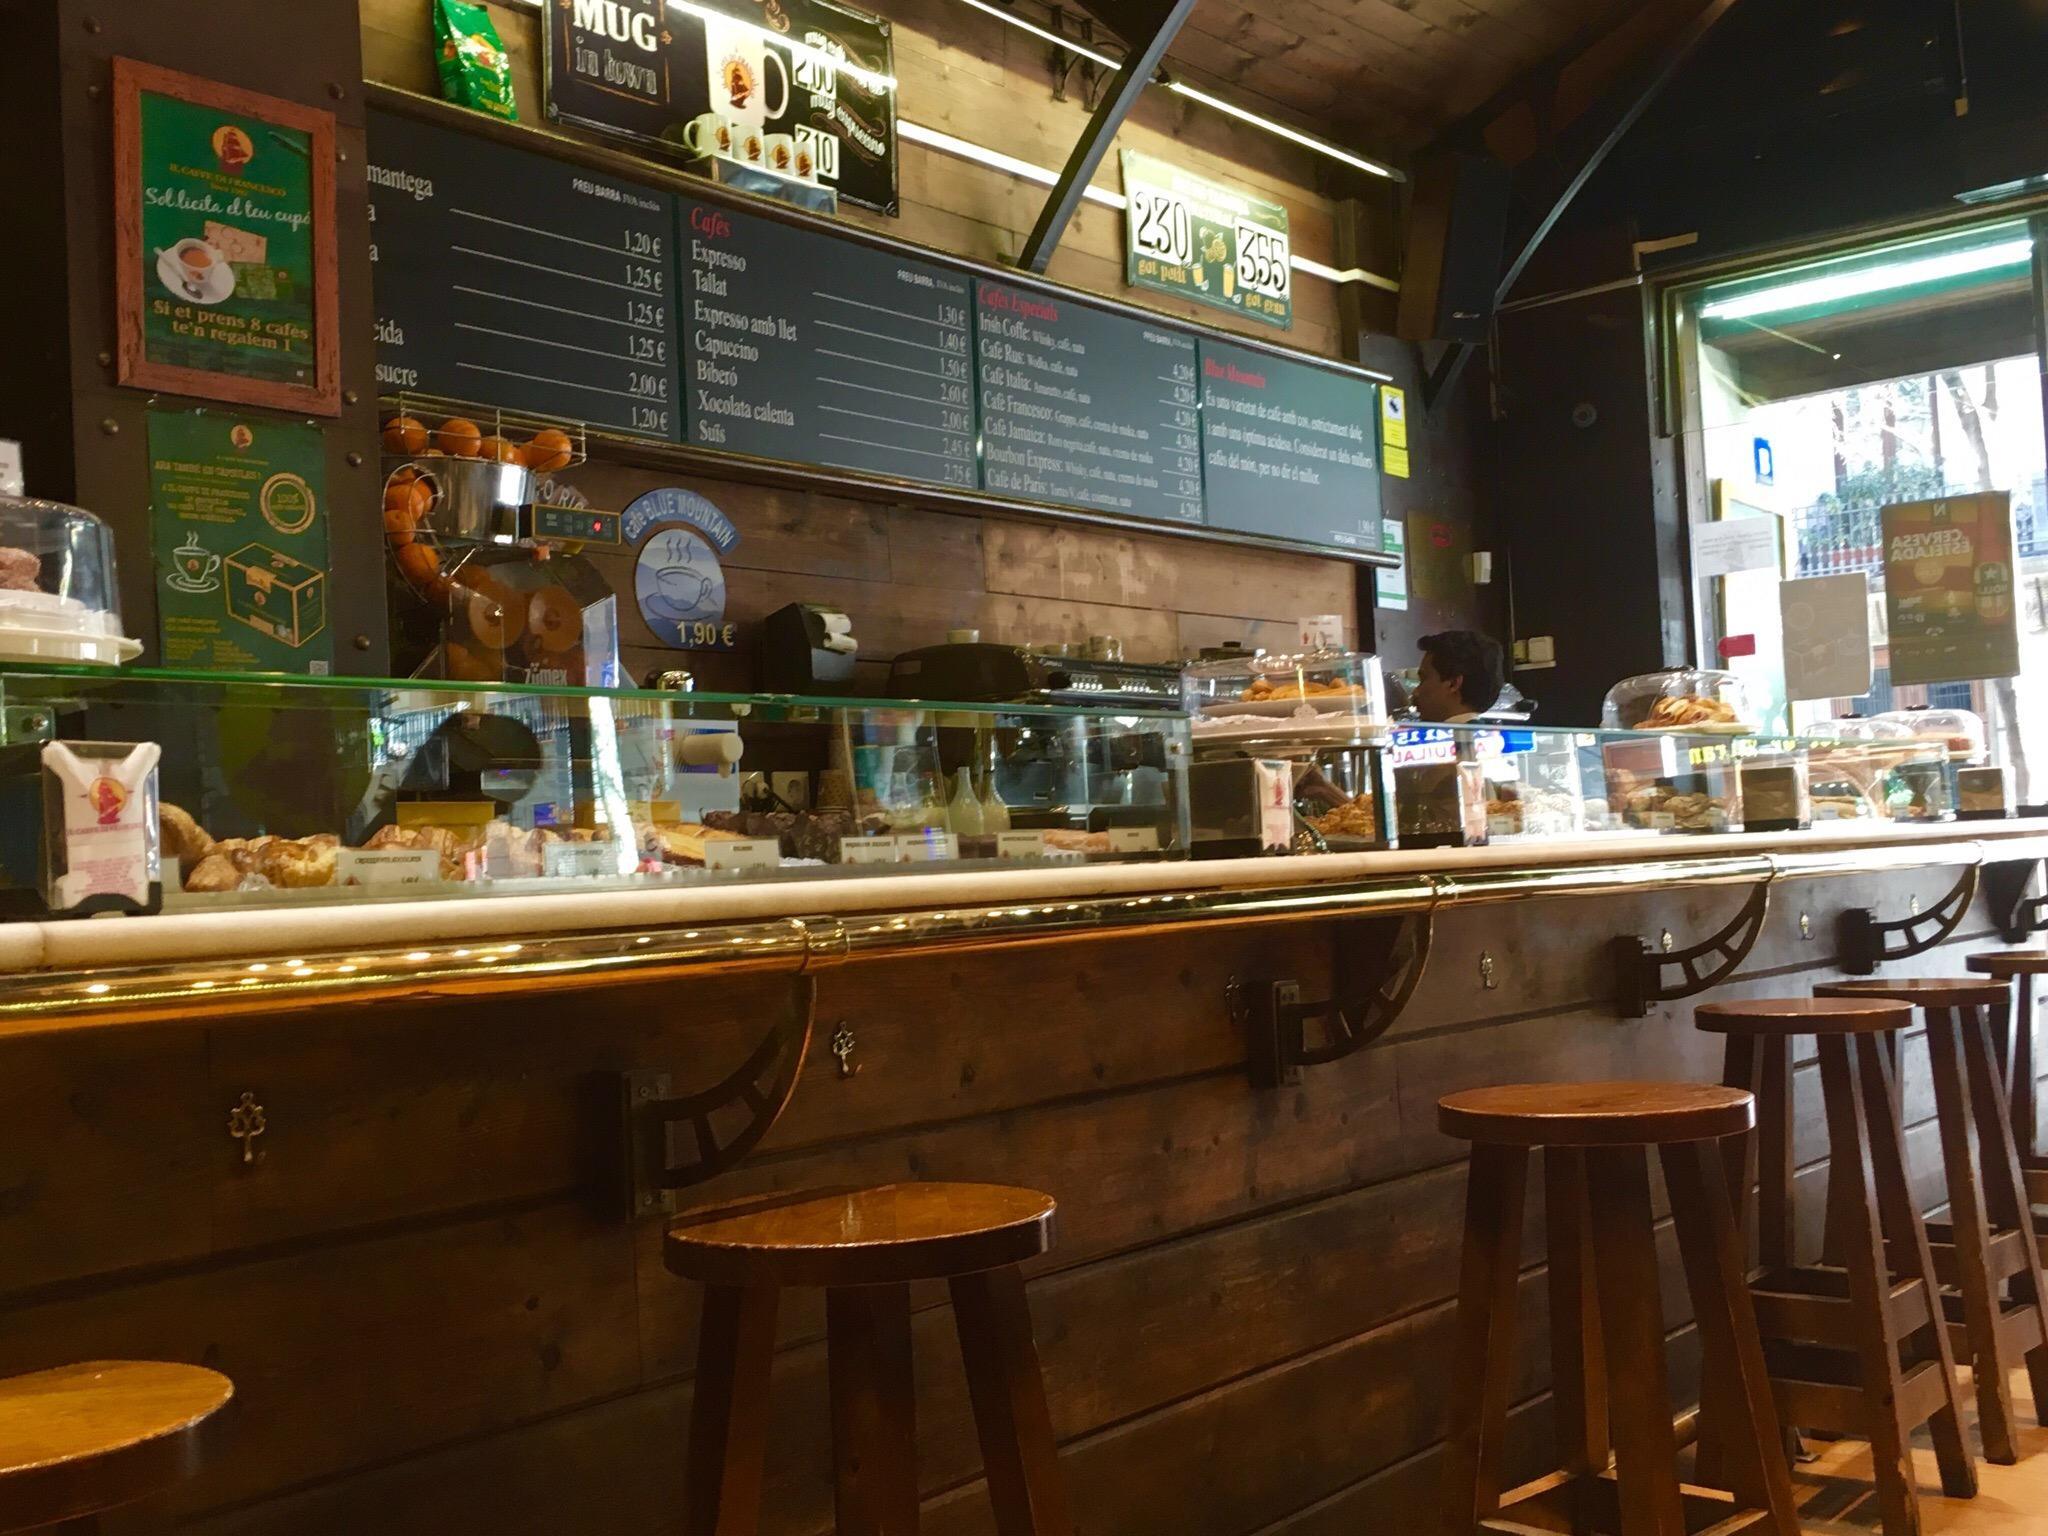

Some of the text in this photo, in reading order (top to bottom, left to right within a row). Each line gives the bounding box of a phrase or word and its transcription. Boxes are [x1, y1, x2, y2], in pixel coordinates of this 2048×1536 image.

[573, 0, 658, 52] MUG
[576, 36, 658, 96] in town
[595, 184, 621, 202] BARRA
[226, 197, 242, 216] el
[245, 199, 272, 220] teu
[275, 211, 311, 232] cupó
[692, 239, 746, 272] Expresso
[154, 300, 170, 315] Si
[174, 305, 191, 319] et
[197, 310, 246, 329] prens
[250, 317, 261, 331] 8
[694, 299, 749, 330] Expresso
[751, 315, 776, 336] amb
[210, 327, 276, 349] regalem
[284, 339, 291, 352] 1
[375, 362, 418, 387] sucre
[697, 389, 752, 419] Xocolata
[753, 401, 795, 426] calenta
[642, 493, 675, 520] BLUE
[677, 494, 735, 548] MOUNTAIN
[677, 622, 735, 648] 1,90 €
